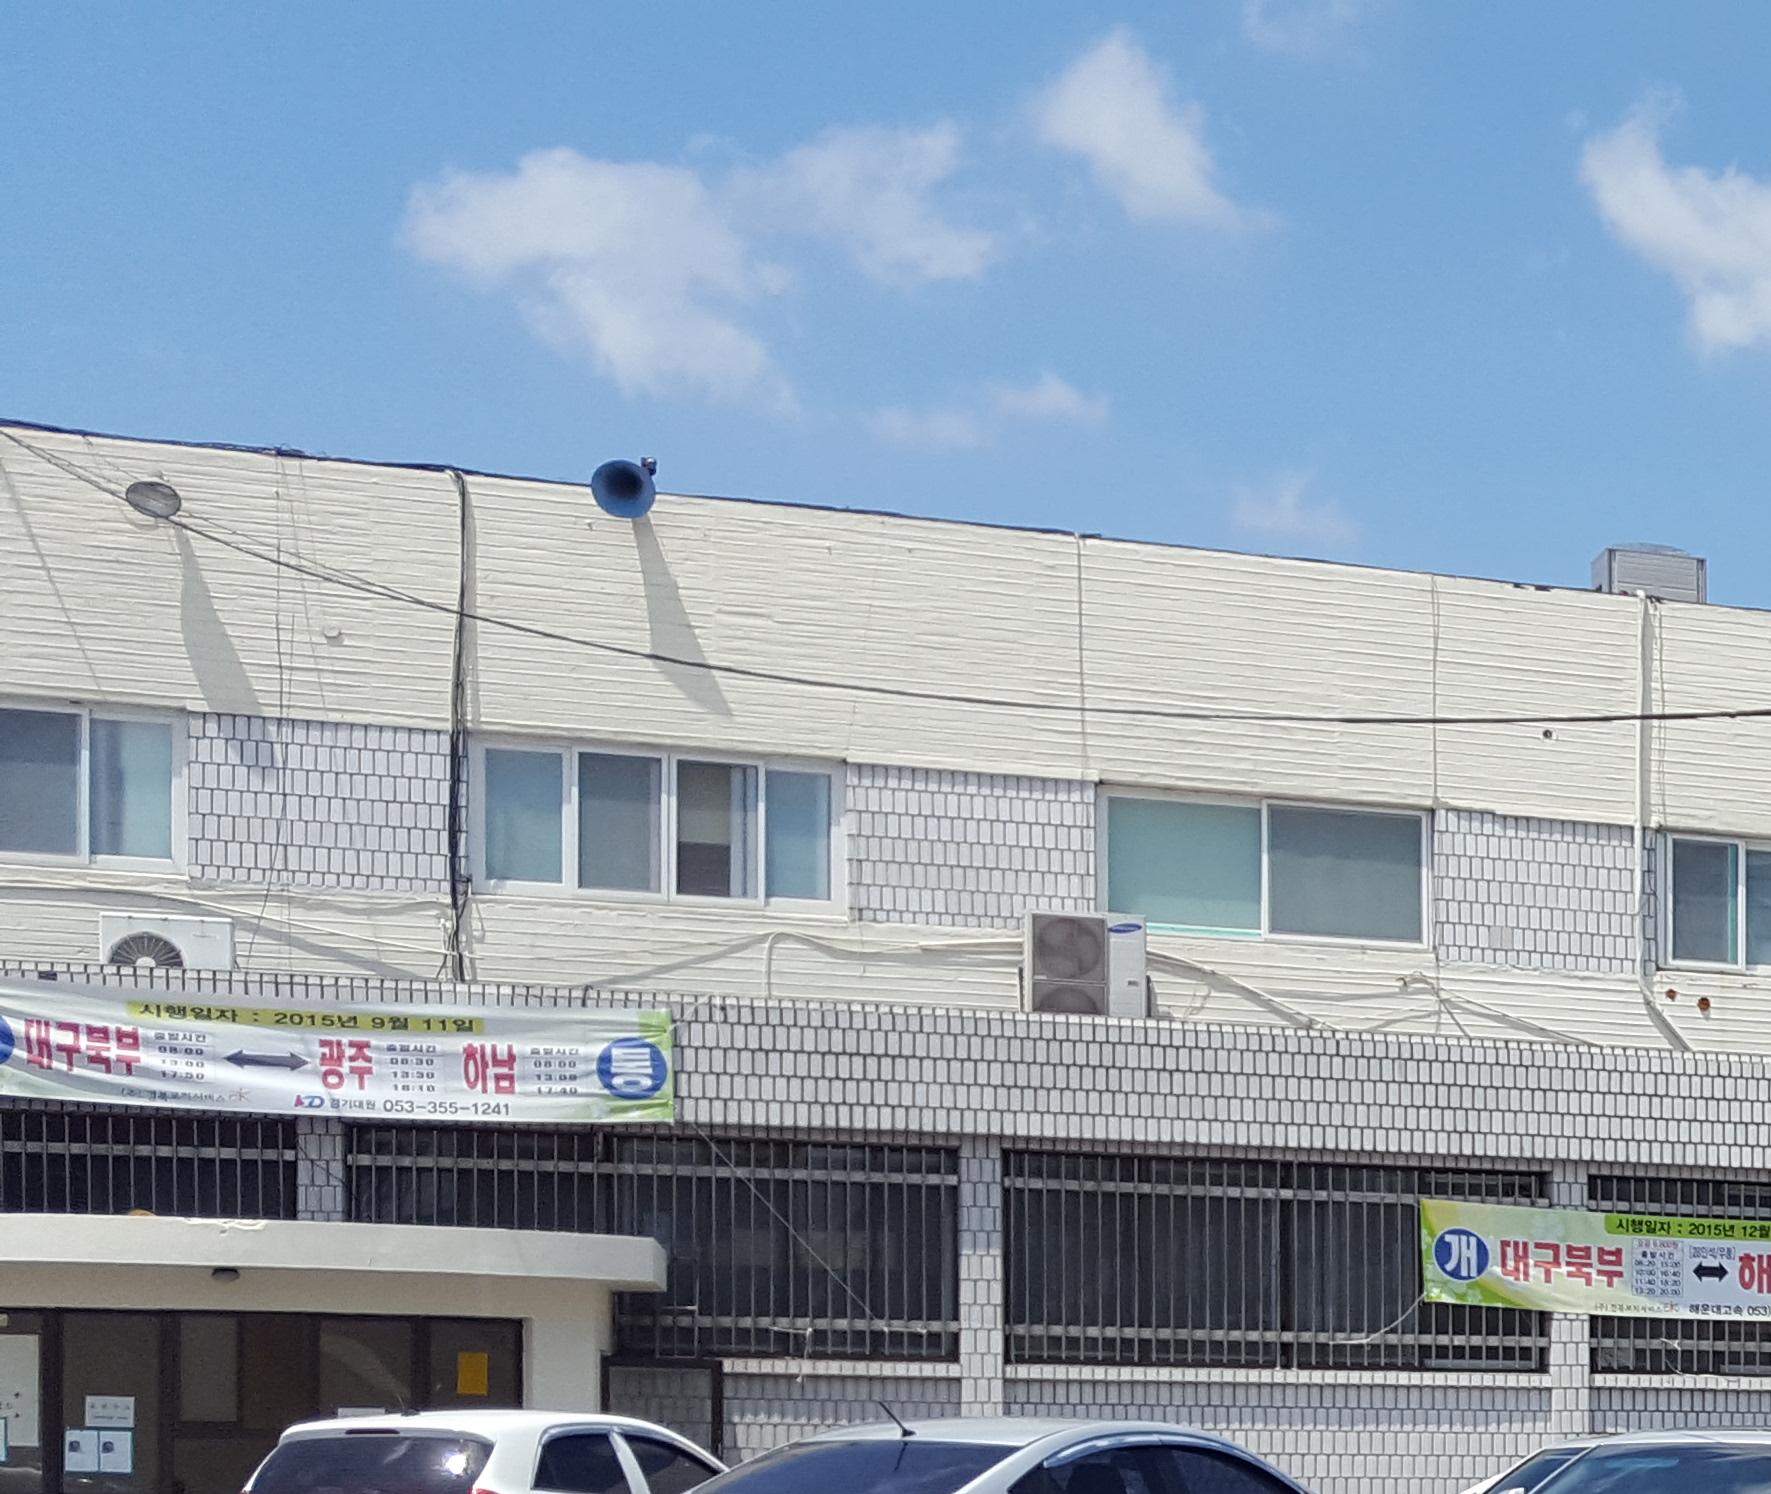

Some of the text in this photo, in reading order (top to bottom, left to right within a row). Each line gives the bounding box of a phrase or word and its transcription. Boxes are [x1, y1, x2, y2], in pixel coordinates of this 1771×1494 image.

[140, 1003, 238, 1022] 시행일자
[274, 1012, 360, 1029] 2015년
[371, 1016, 409, 1031] 9월
[423, 1017, 475, 1033] 11일
[24, 1018, 141, 1077] 대구북부
[319, 1038, 374, 1090] 광주
[462, 1042, 517, 1095] 하남
[383, 1100, 510, 1117] 053-355-1241
[1616, 1217, 1672, 1234] 시행일자
[1688, 1221, 1735, 1238] 2015년
[1741, 1224, 1771, 1239] 12월
[1443, 1233, 1478, 1278] 개
[1499, 1239, 1625, 1288] 대구북부
[1688, 1303, 1745, 1316] 해운대고속
